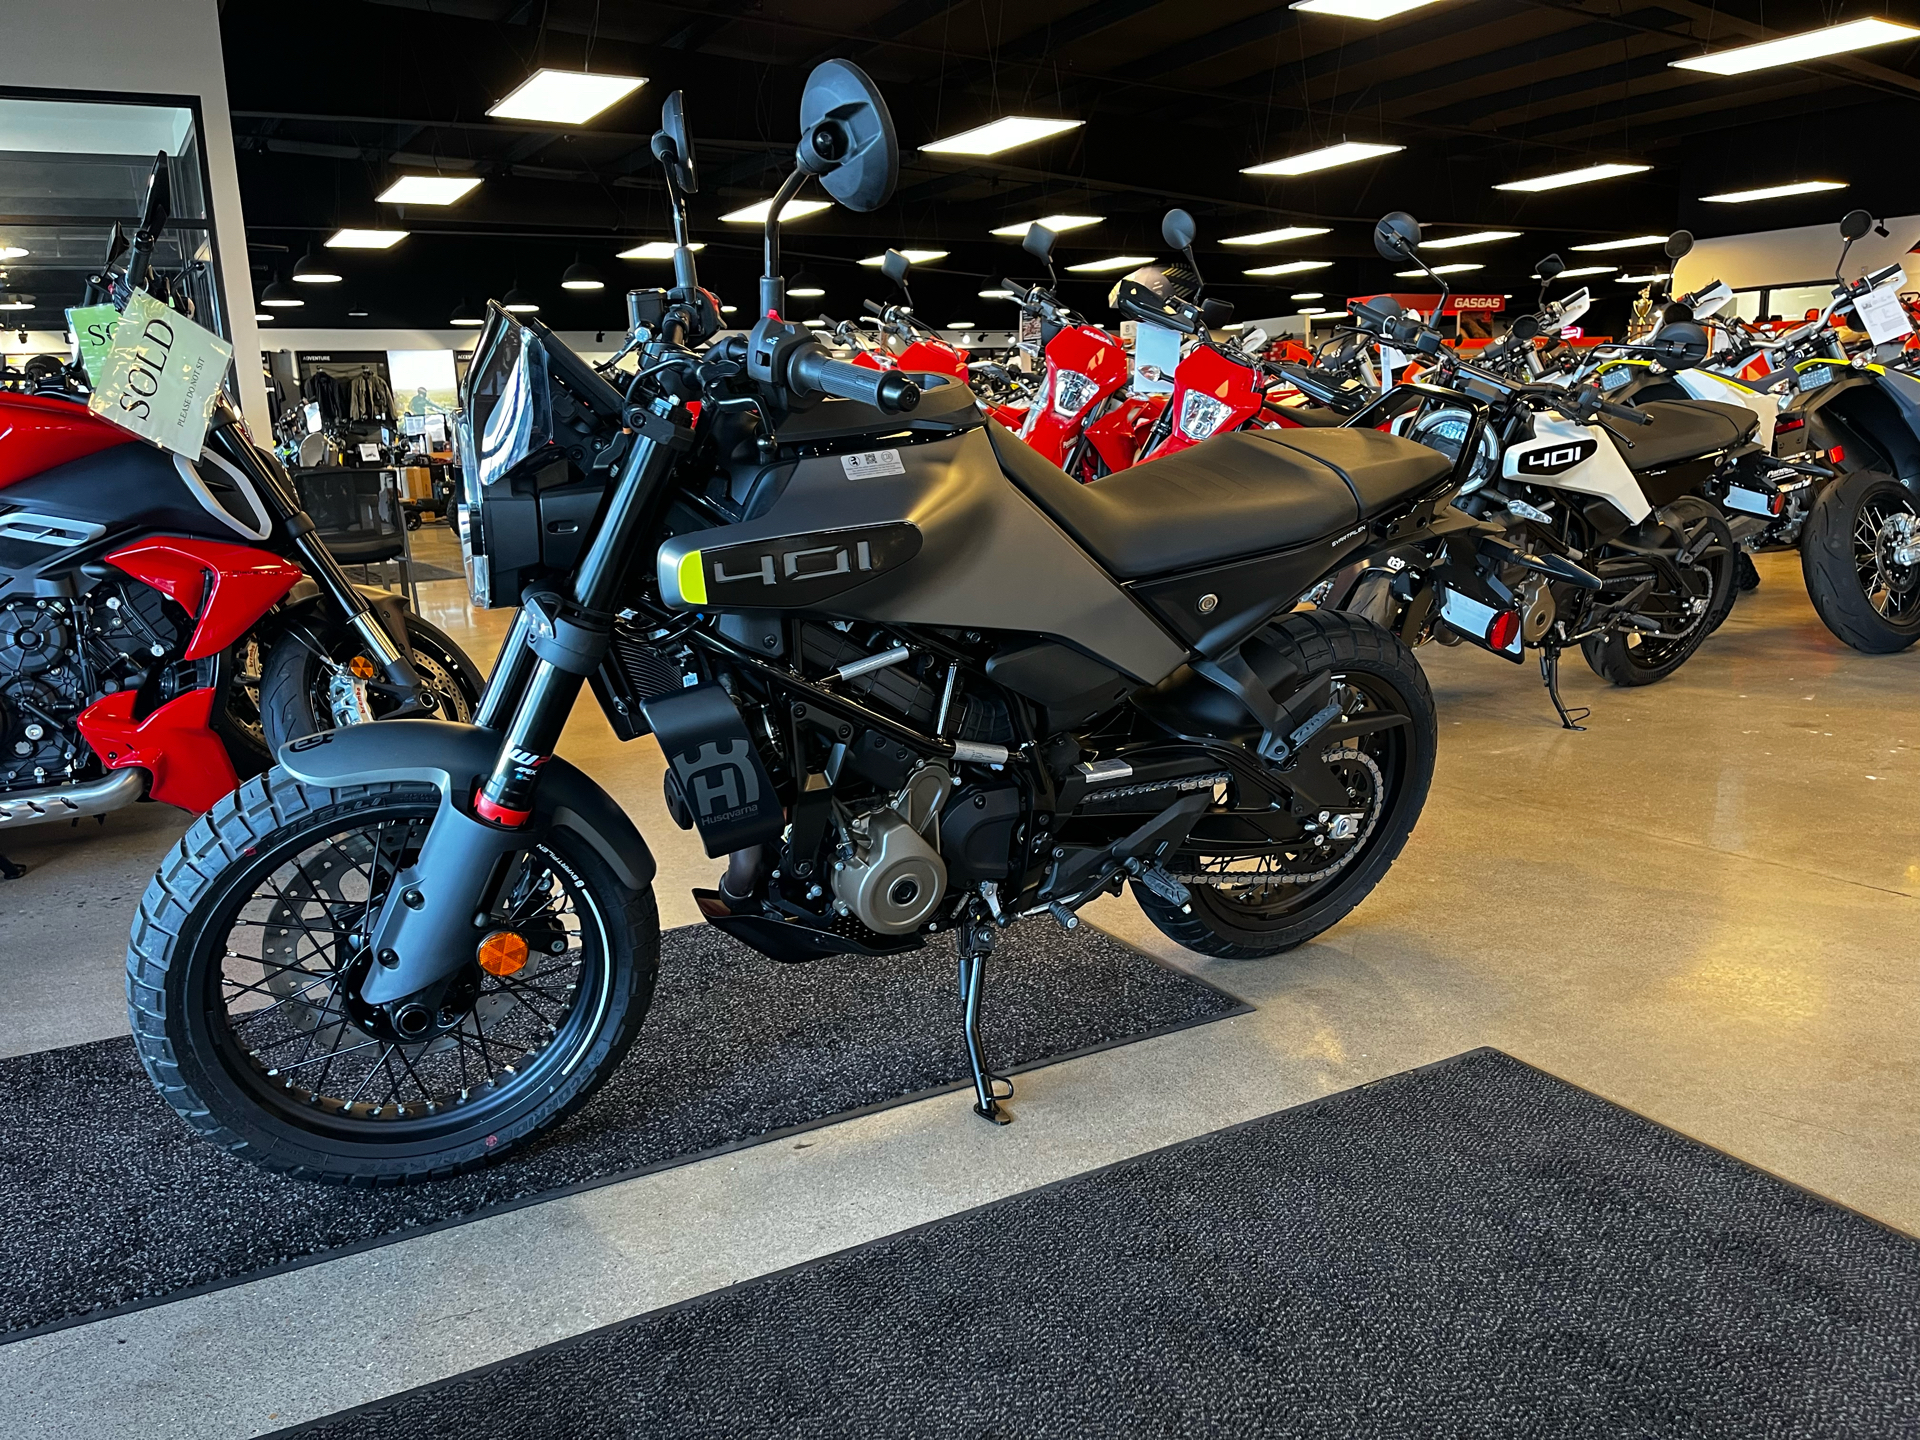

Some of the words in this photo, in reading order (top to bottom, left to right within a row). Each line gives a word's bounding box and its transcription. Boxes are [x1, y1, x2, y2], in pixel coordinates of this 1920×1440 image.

[1454, 298, 1501, 308] GASGAS
[119, 318, 175, 422] SOLD
[198, 357, 206, 370] SIT
[191, 370, 201, 387] NOT
[187, 386, 196, 400] DO
[177, 399, 192, 428] PLEASE
[1529, 446, 1581, 467] 401
[713, 540, 873, 585] 401
[513, 766, 538, 776] APEX
[272, 797, 382, 845] PIRELLI
[701, 804, 758, 826] Husqvarna
[536, 843, 579, 881] SVARTPILEN
